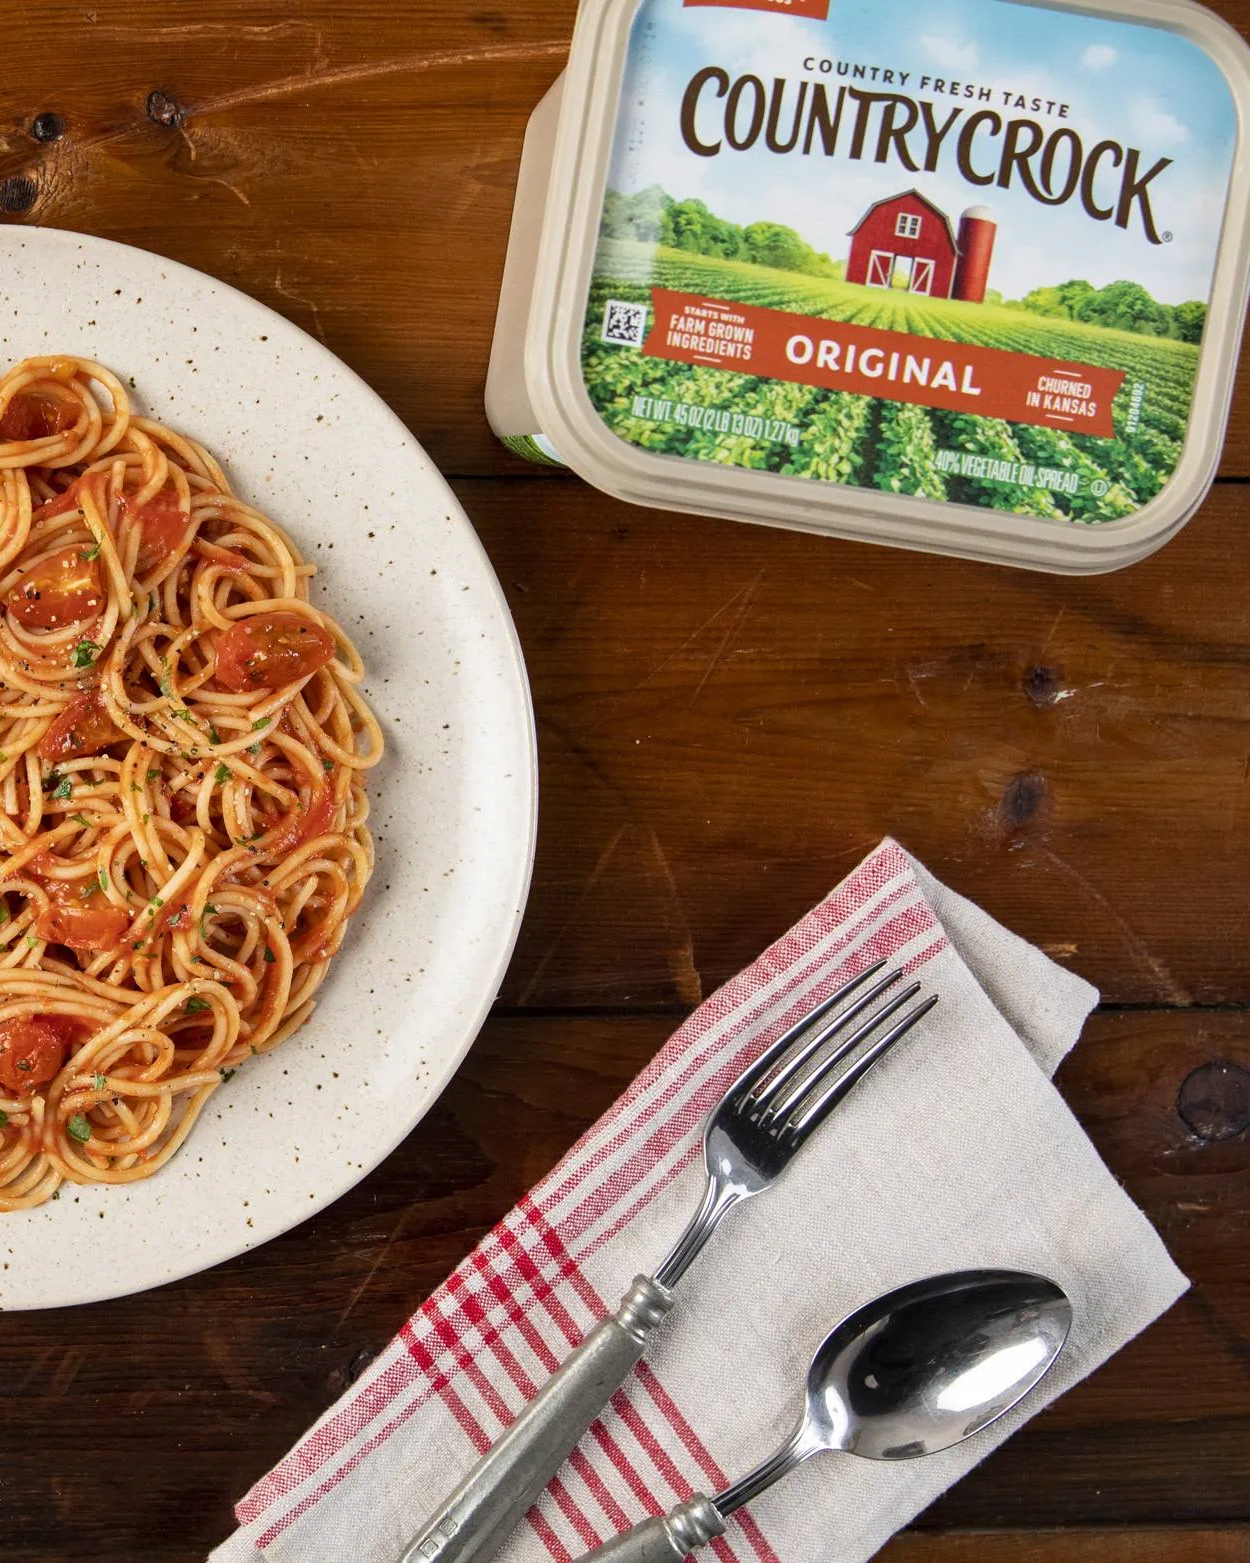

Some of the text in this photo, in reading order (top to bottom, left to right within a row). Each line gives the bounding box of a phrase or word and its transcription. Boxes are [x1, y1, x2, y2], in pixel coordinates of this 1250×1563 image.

[803, 57, 1070, 119] COUNTRY FRESH TASTE
[669, 314, 754, 343] FARM GROWN
[684, 306, 745, 324] STARTS WITH
[666, 331, 753, 360] INGREDIENTS
[785, 335, 982, 396] ORIGINAL
[1037, 375, 1092, 399] CHURNED
[1025, 391, 1097, 417] IN KANSAS
[631, 395, 653, 418] NET
[673, 402, 688, 425] 45
[688, 406, 703, 427] OZ
[715, 410, 730, 432] LB
[731, 413, 744, 435] 13
[744, 415, 763, 440] OZ)
[786, 423, 800, 447] kg
[935, 449, 1079, 494] 40% VEGETABLE OIL SPREAD
